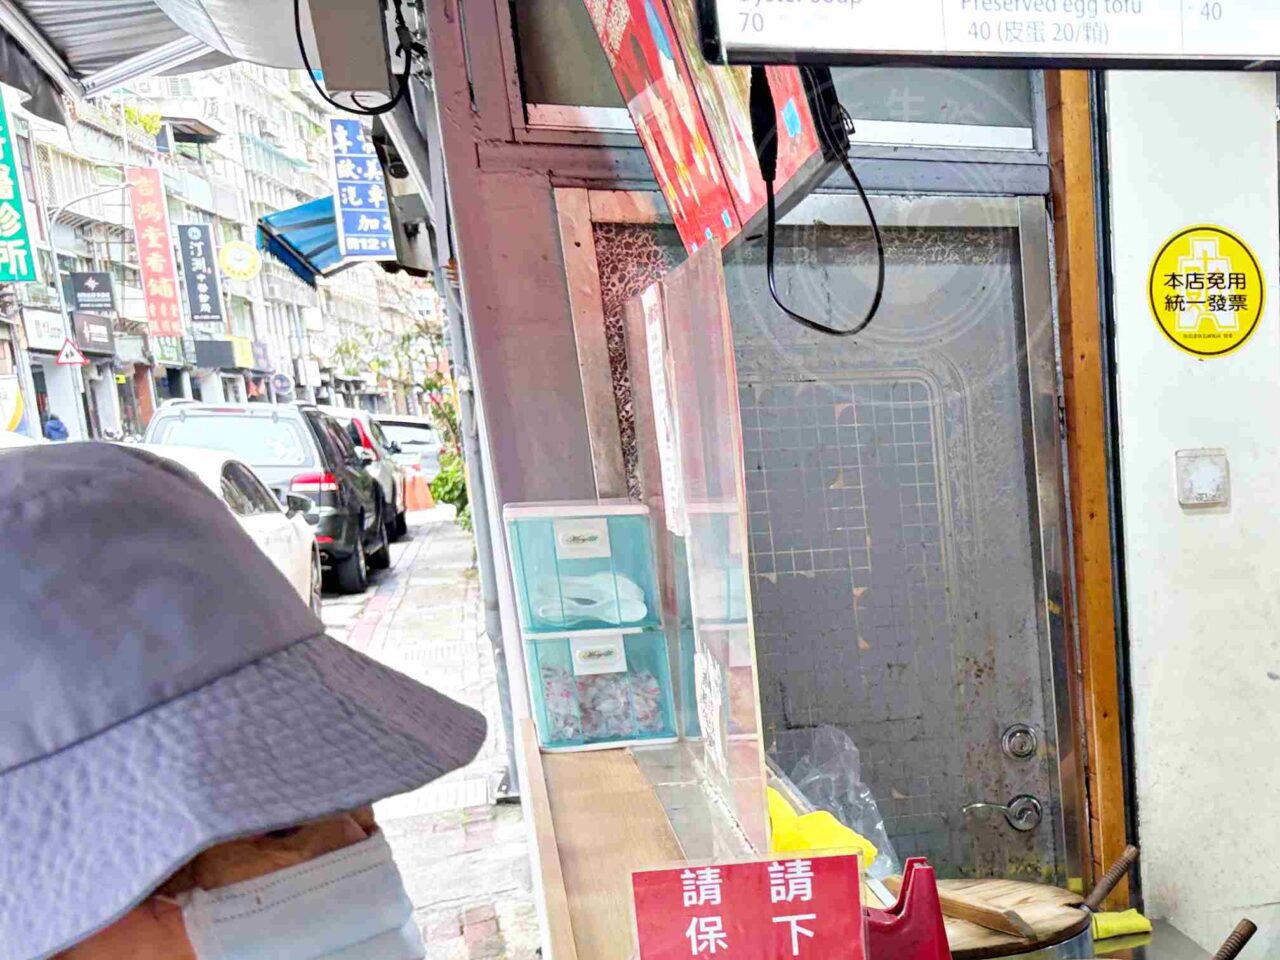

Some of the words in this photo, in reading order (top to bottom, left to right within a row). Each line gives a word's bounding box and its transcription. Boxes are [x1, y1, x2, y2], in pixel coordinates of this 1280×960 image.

[1063, 0, 1098, 18] egg
[1200, 3, 1222, 21] 40
[739, 12, 764, 32] 70
[968, 21, 991, 40] 40
[1163, 272, 1247, 290] 本店免用
[1164, 294, 1248, 312] 統一發票
